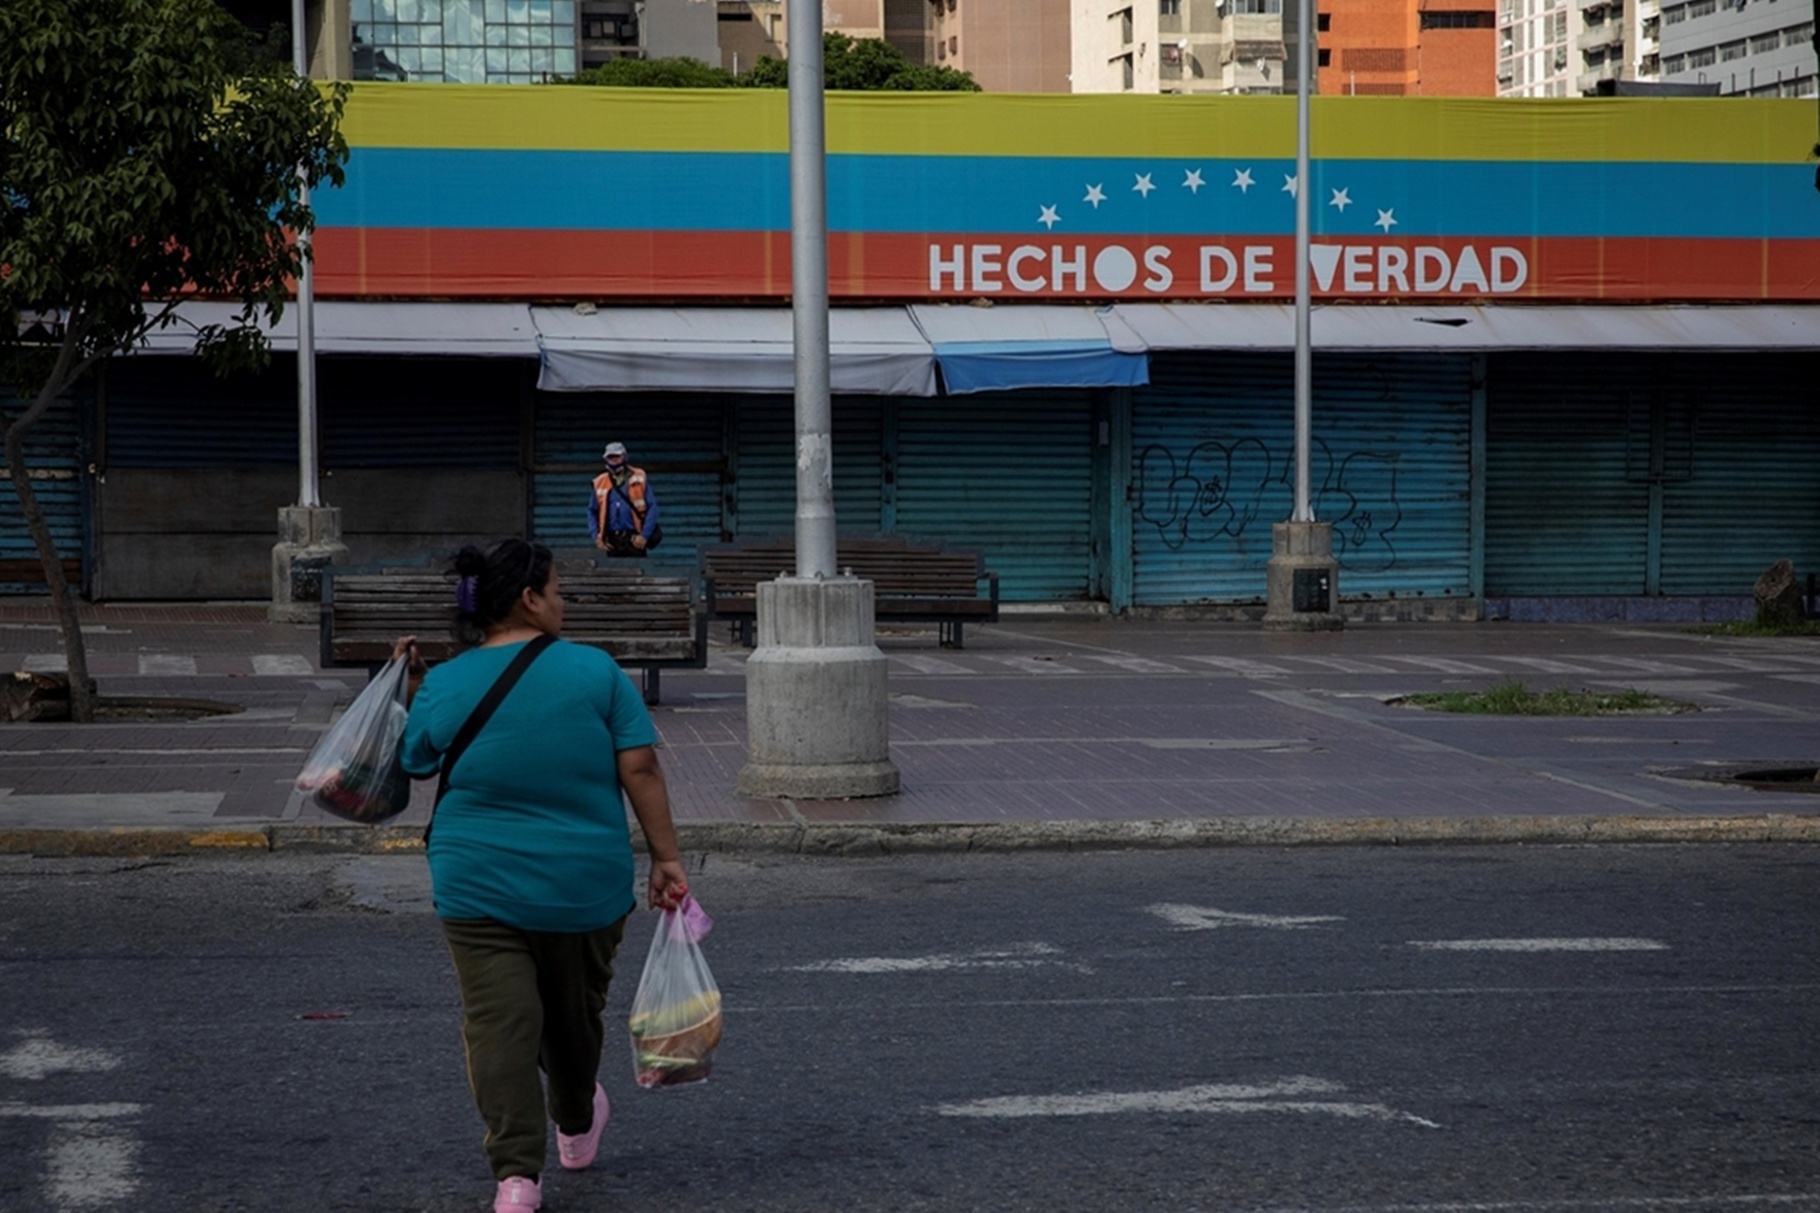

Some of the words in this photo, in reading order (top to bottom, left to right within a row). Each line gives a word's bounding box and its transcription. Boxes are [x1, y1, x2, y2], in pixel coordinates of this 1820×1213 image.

[929, 245, 1173, 292] HECHOS
[1200, 246, 1274, 292] DE
[1309, 244, 1528, 292] VERDAD
